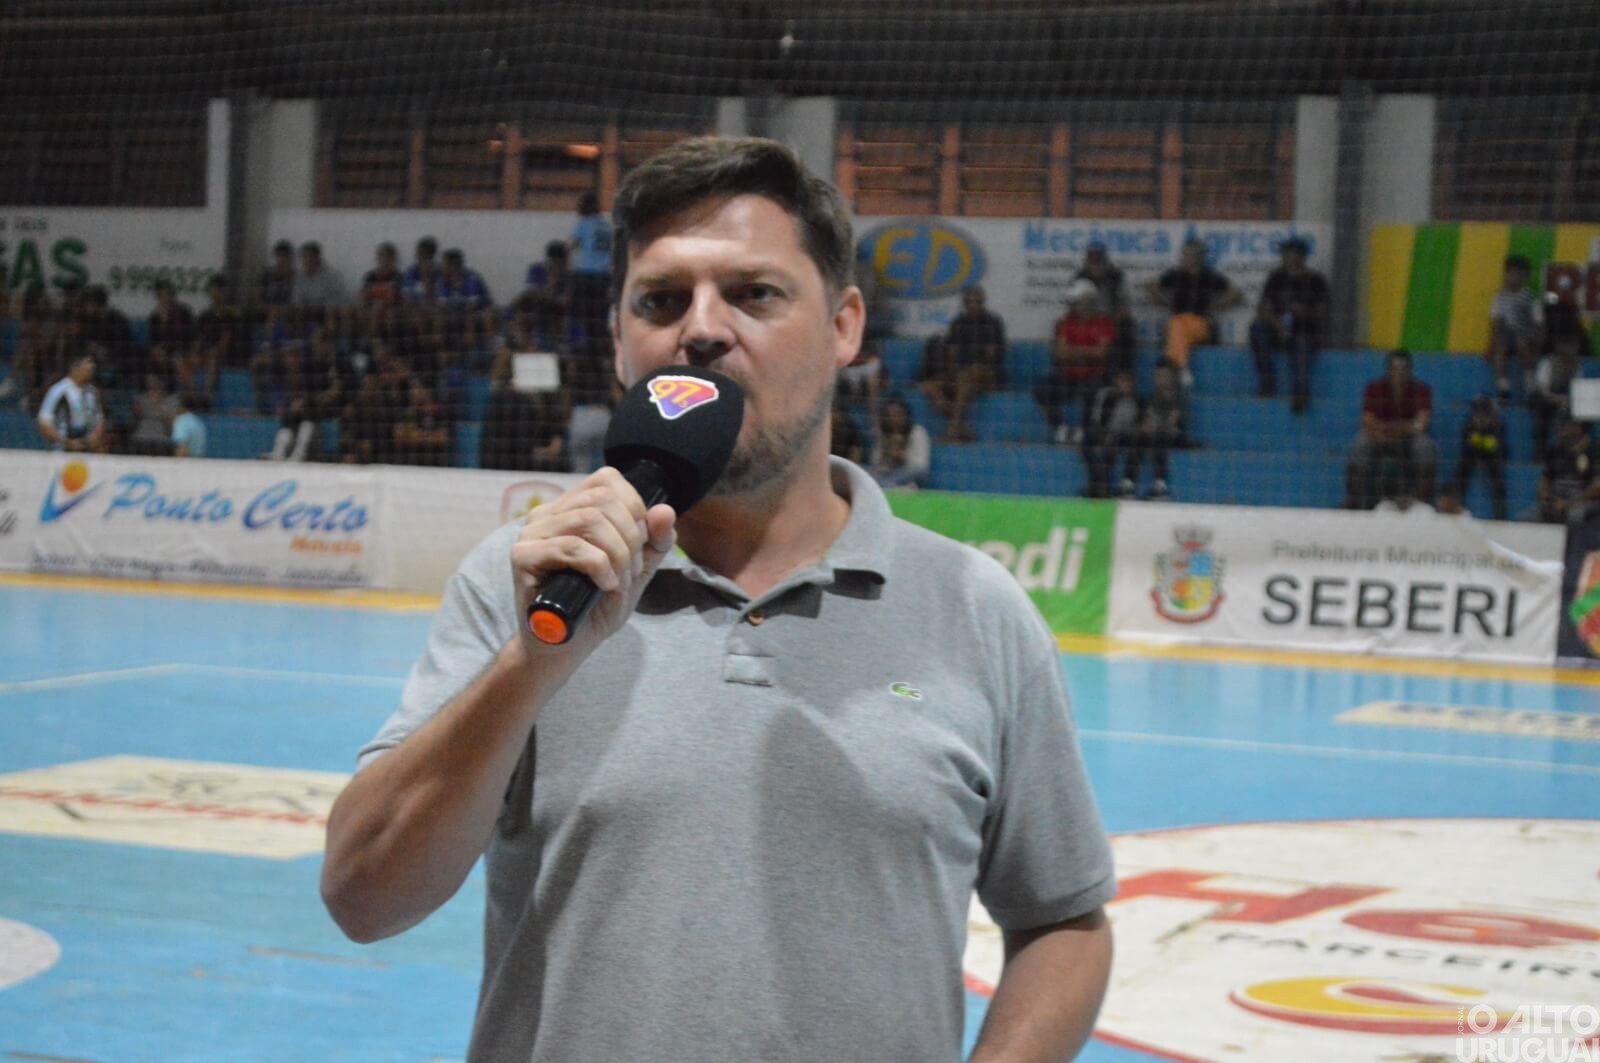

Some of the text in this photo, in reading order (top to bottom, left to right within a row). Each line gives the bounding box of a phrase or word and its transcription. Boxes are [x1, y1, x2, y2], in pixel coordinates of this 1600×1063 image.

[0, 236, 91, 289] AS
[873, 227, 973, 290] ED
[654, 381, 702, 404] 97
[103, 472, 370, 531] Ponto Certo
[1272, 541, 1379, 563] Prefeitura
[1387, 546, 1491, 570] Municipal
[1262, 573, 1519, 639] SEBERI
